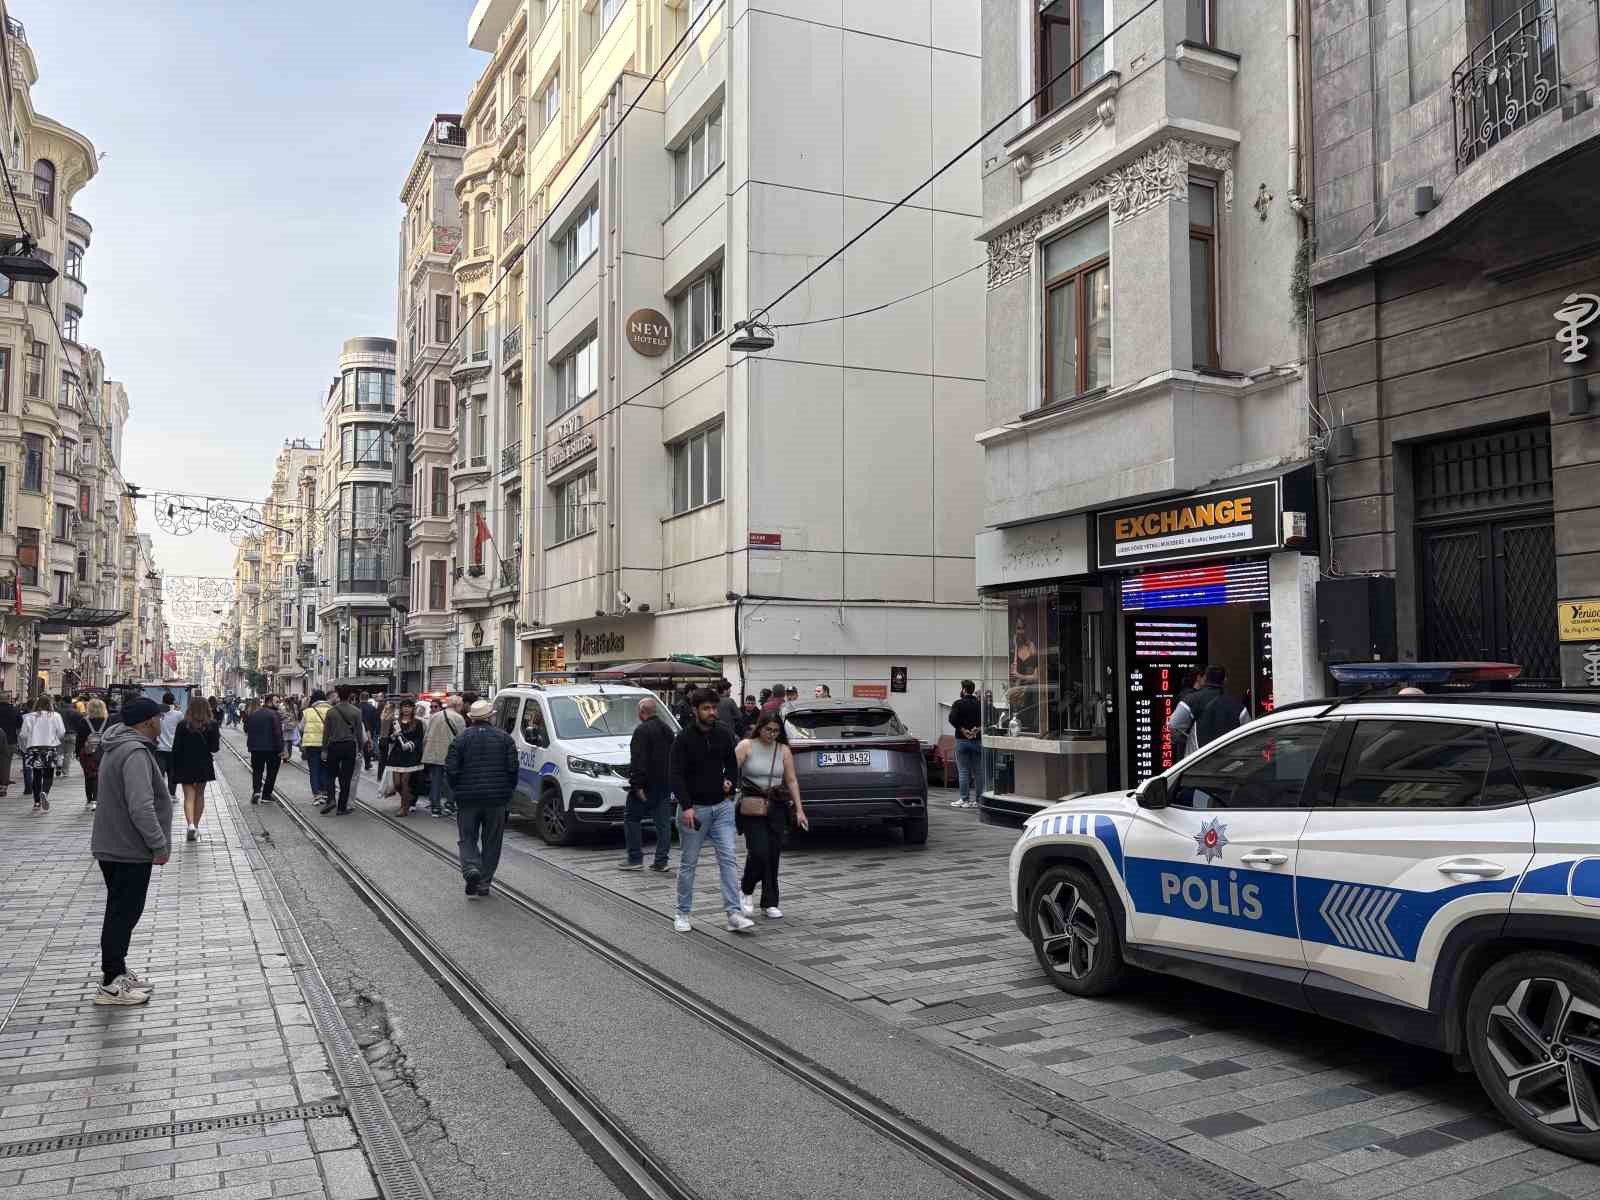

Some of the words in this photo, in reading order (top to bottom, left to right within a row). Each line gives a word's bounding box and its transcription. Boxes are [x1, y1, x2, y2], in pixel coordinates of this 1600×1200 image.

[631, 321, 669, 338] NEVI
[634, 335, 668, 346] HOTELS
[1115, 497, 1252, 540] EXCHANGE
[824, 753, 833, 762] 34
[1160, 870, 1264, 920] POLİS
